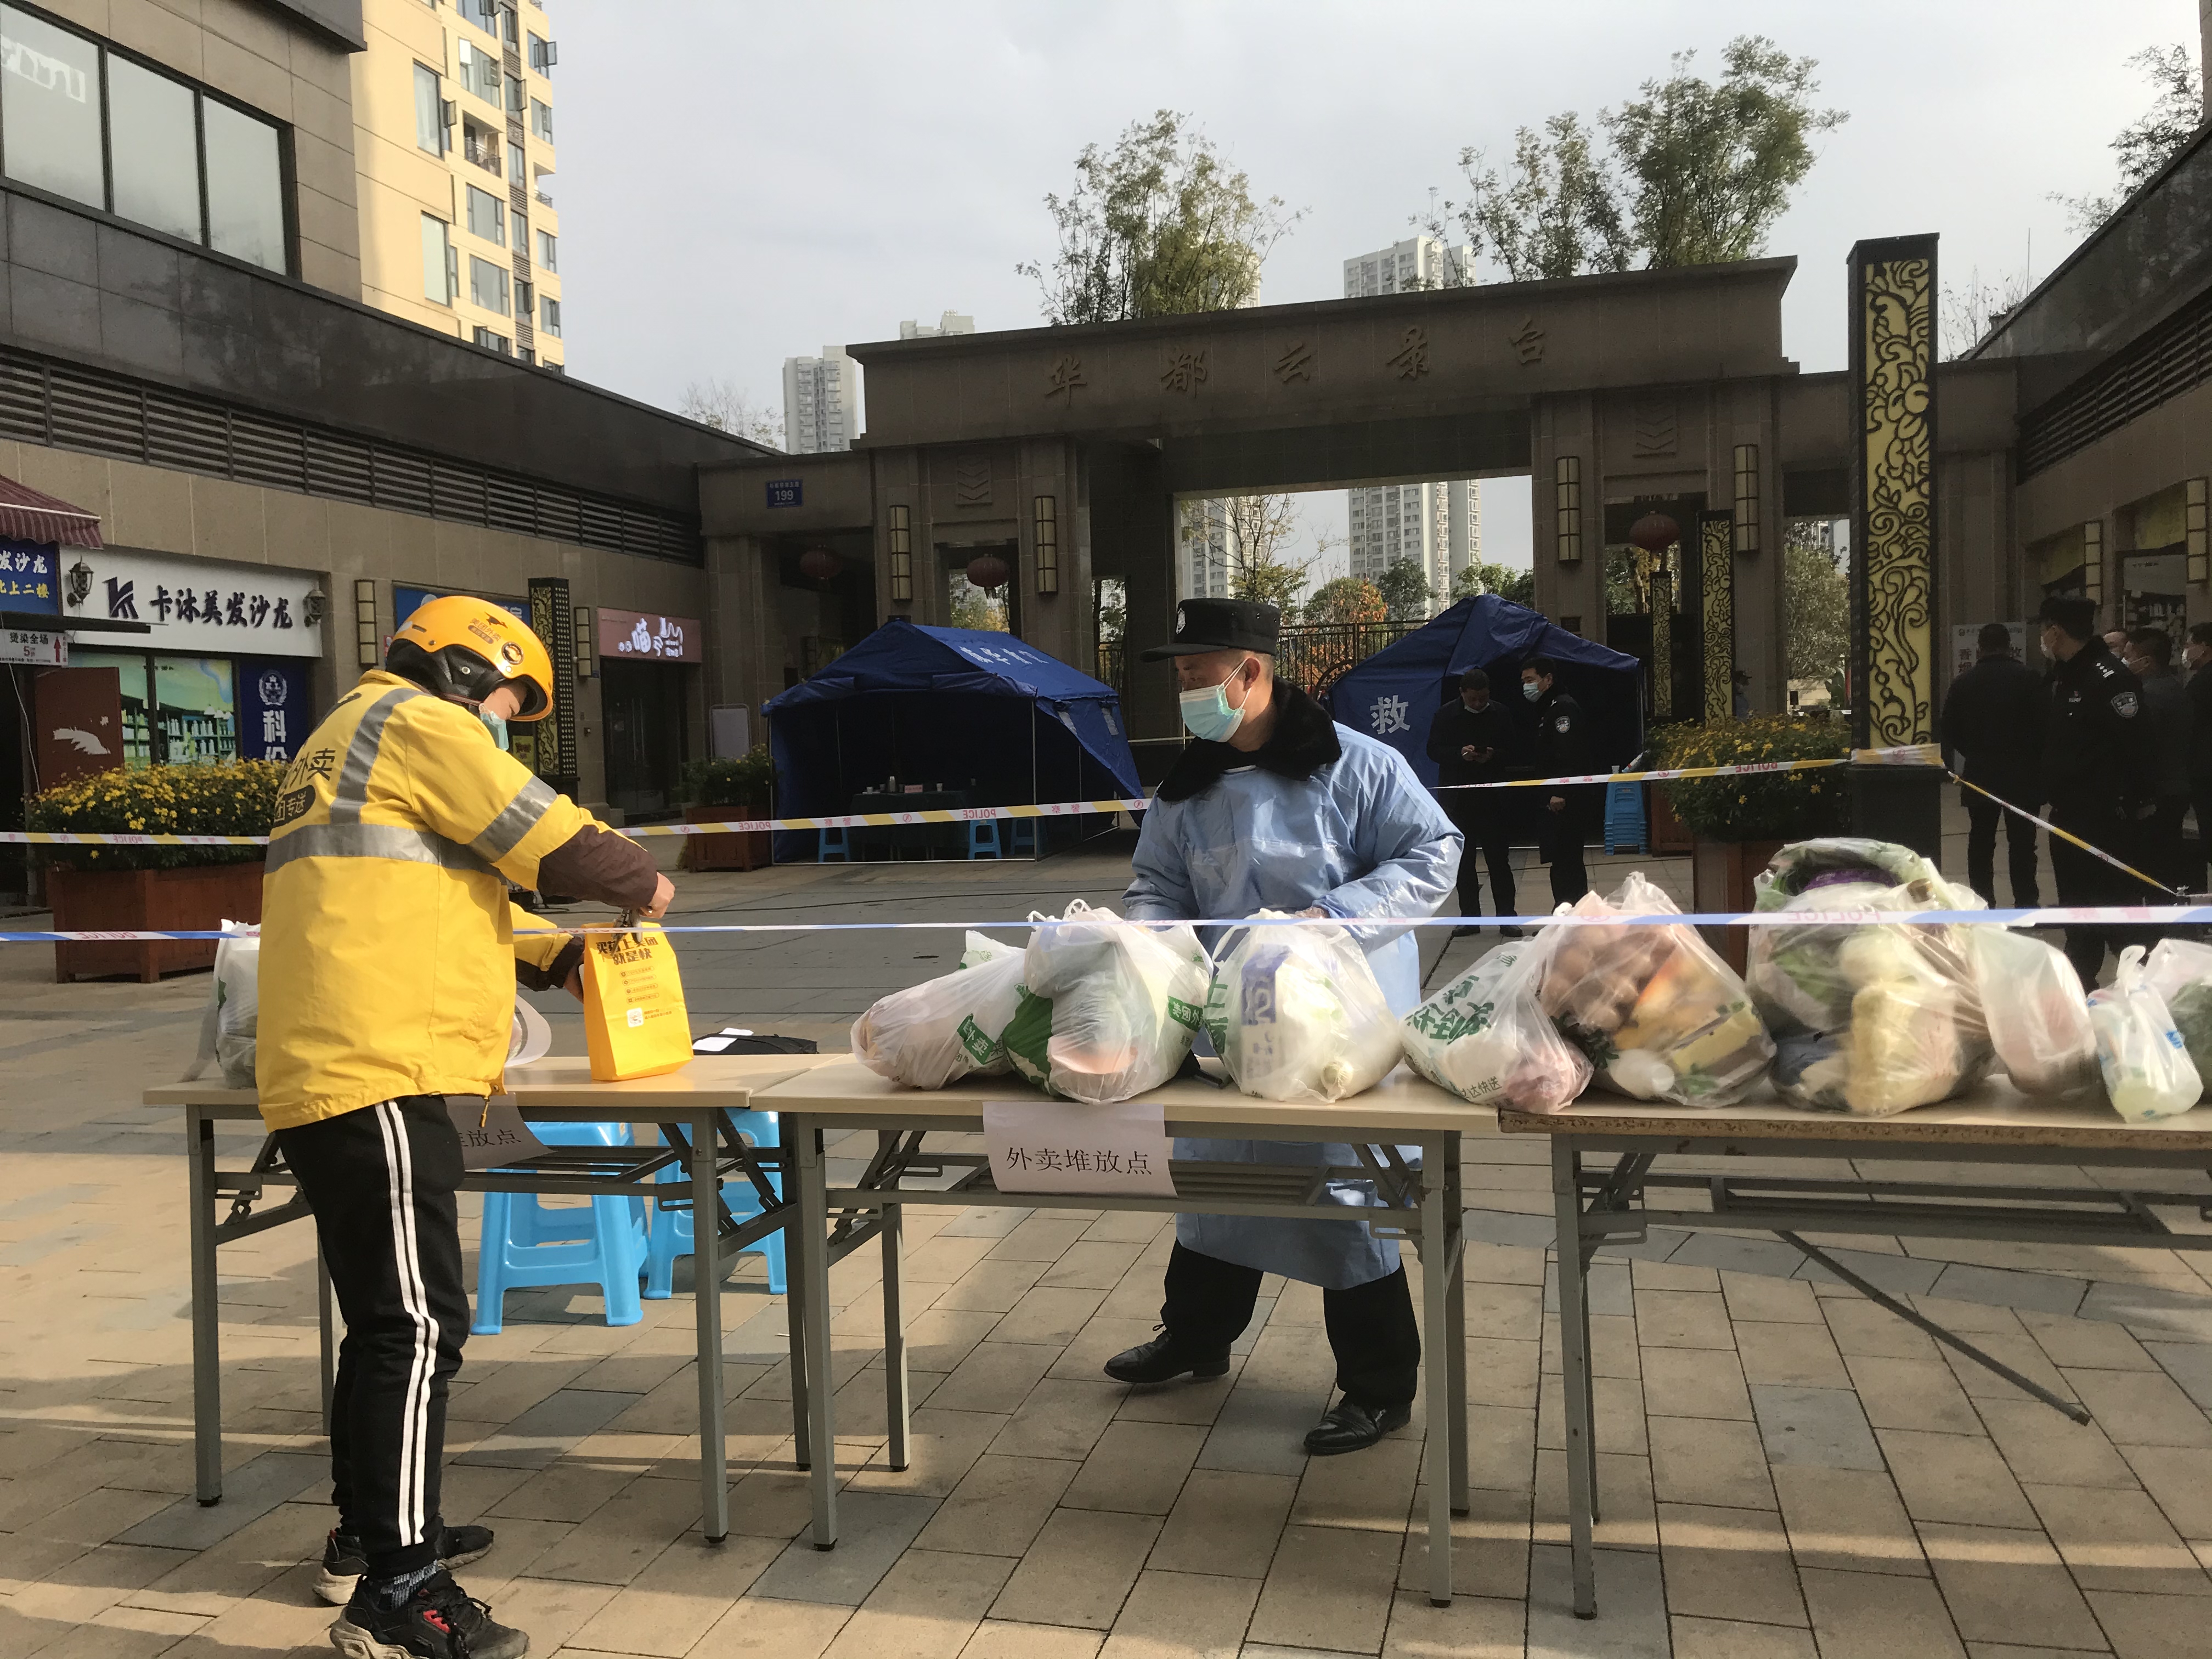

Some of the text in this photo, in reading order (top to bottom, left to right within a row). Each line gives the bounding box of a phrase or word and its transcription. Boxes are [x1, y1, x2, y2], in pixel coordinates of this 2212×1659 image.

[775, 490, 794, 500] 199
[150, 584, 294, 629] 卡沐美发沙龙
[1369, 695, 1410, 735] 救
[612, 947, 653, 966] 就是快
[1006, 1147, 1152, 1175] 外卖堆放点
